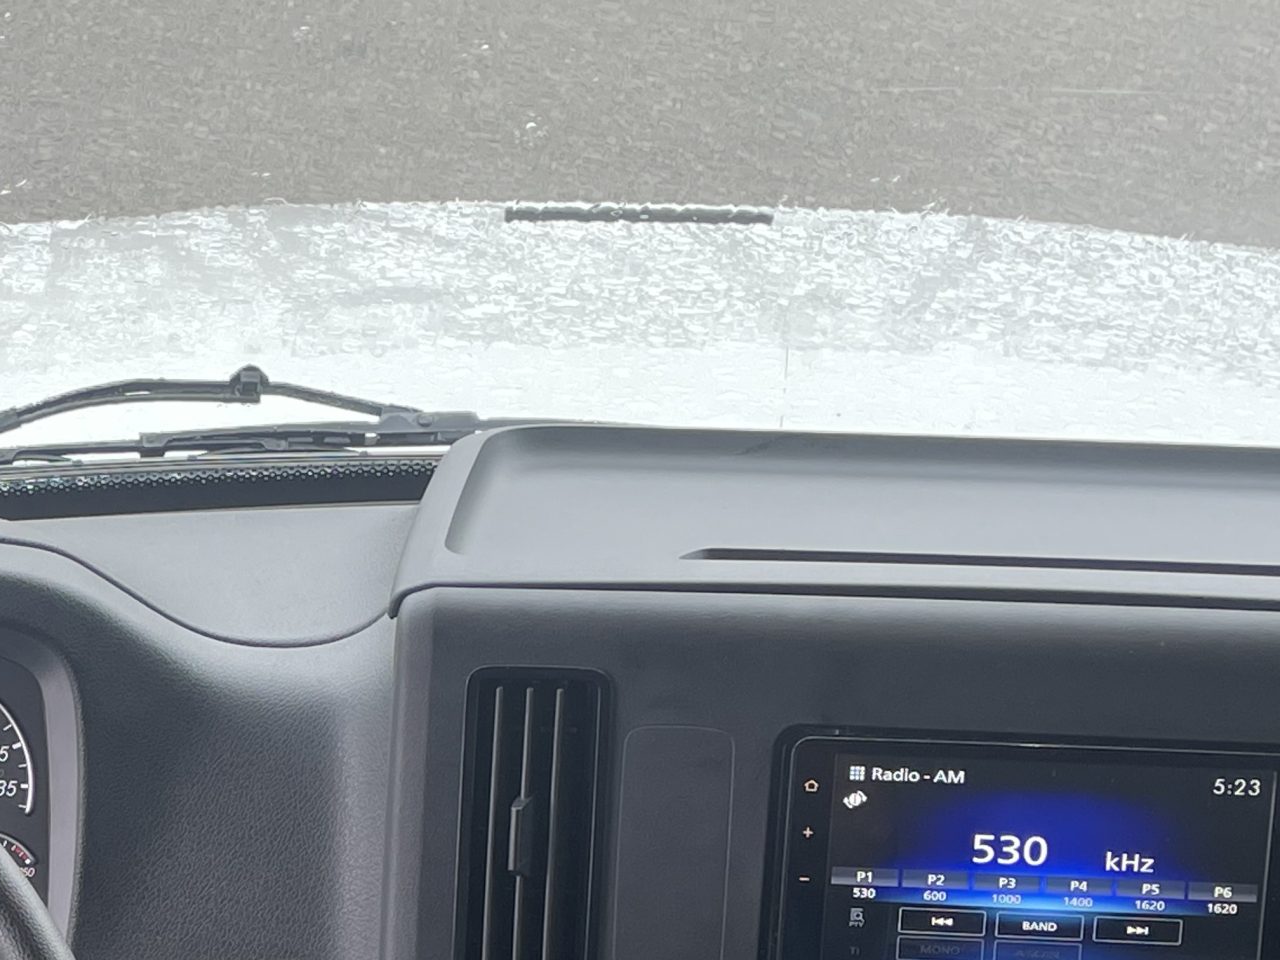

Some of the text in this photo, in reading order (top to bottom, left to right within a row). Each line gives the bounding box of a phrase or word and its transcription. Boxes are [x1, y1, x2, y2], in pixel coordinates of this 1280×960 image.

[871, 766, 920, 782] Radio
[933, 770, 966, 784] AM
[1212, 778, 1261, 796] 5:23
[972, 833, 1048, 866] 530
[1104, 851, 1154, 874] kHz
[856, 871, 873, 883] P1
[927, 874, 945, 886] P2
[998, 877, 1017, 889] P3
[1070, 880, 1088, 892] P4
[1142, 883, 1160, 895] P5
[852, 888, 876, 899] 530
[923, 890, 947, 901] 600
[992, 893, 1021, 904] 1000
[1214, 886, 1233, 899] P6
[1063, 896, 1094, 908] 1400
[1135, 900, 1166, 911] 1620
[1207, 903, 1238, 915] 1620
[1022, 920, 1058, 932] BAND
[920, 944, 961, 956] MONO
